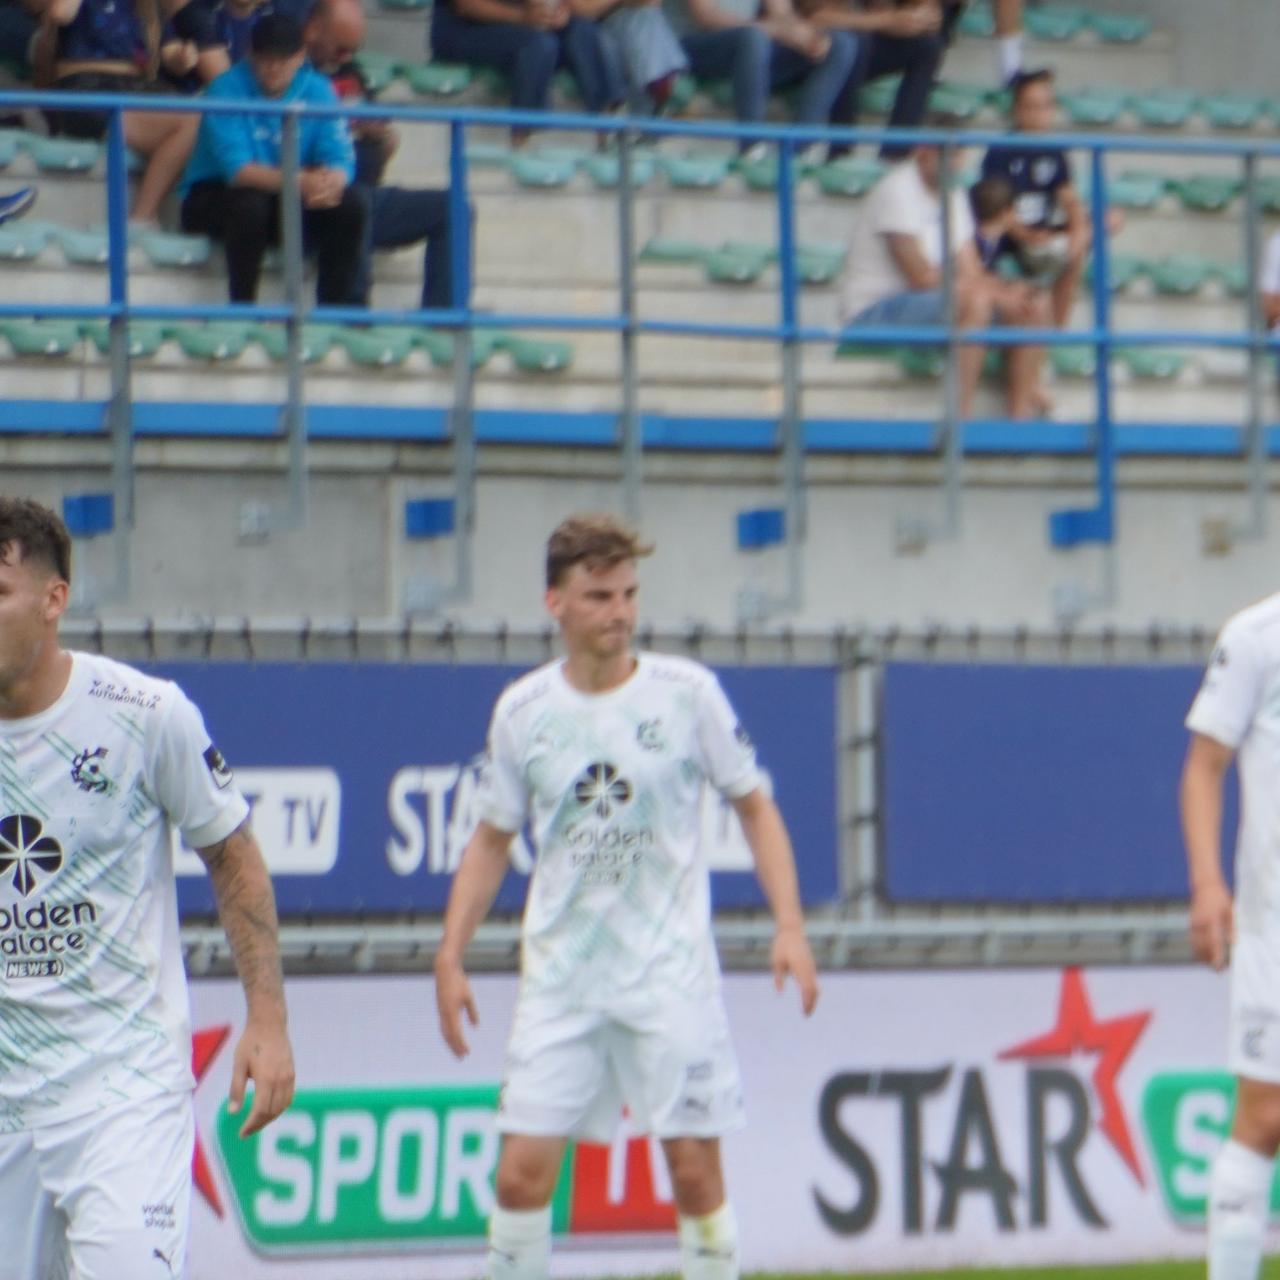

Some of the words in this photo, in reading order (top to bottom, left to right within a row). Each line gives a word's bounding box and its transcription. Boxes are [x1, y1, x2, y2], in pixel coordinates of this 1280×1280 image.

[283, 797, 327, 846] TV
[385, 766, 534, 876] STA
[0, 902, 96, 931] olden
[1, 932, 84, 955] alace
[253, 1105, 501, 1228] SPOR
[812, 1062, 1112, 1240] STAR
